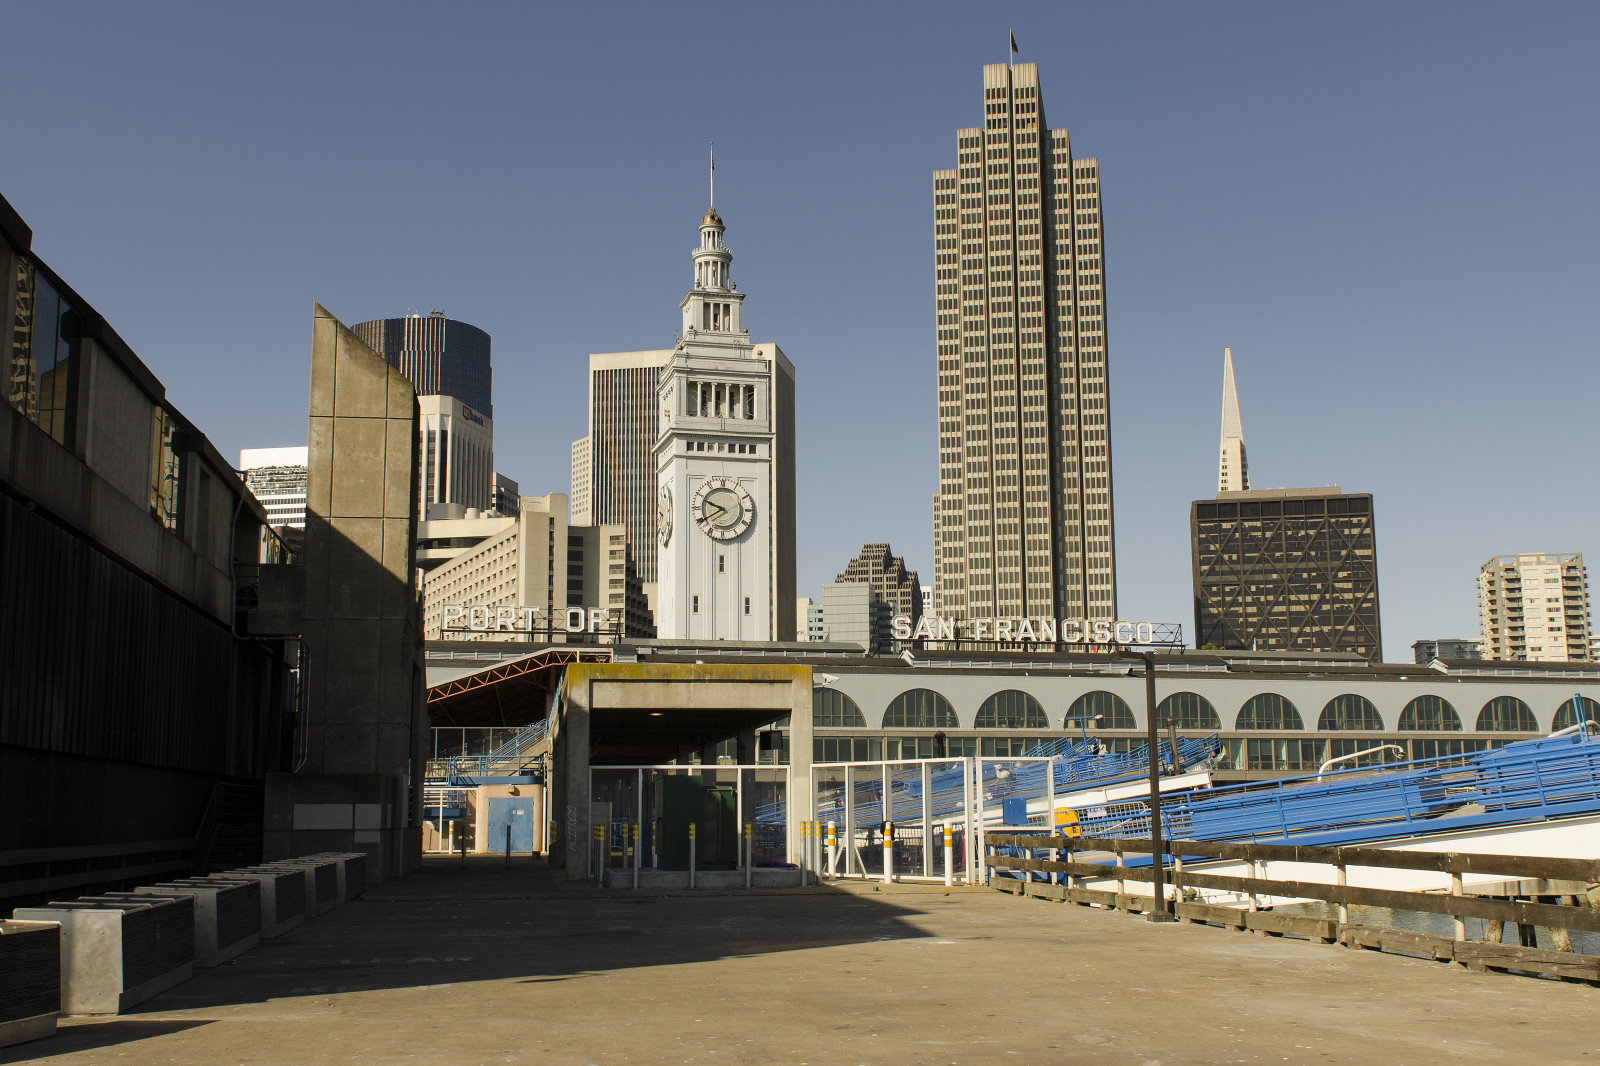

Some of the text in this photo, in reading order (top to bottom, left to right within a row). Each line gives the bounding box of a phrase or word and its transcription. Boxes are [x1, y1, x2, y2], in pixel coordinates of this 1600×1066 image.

[443, 604, 607, 632] PORT OF
[891, 614, 1153, 643] SAN FRANCISCO
